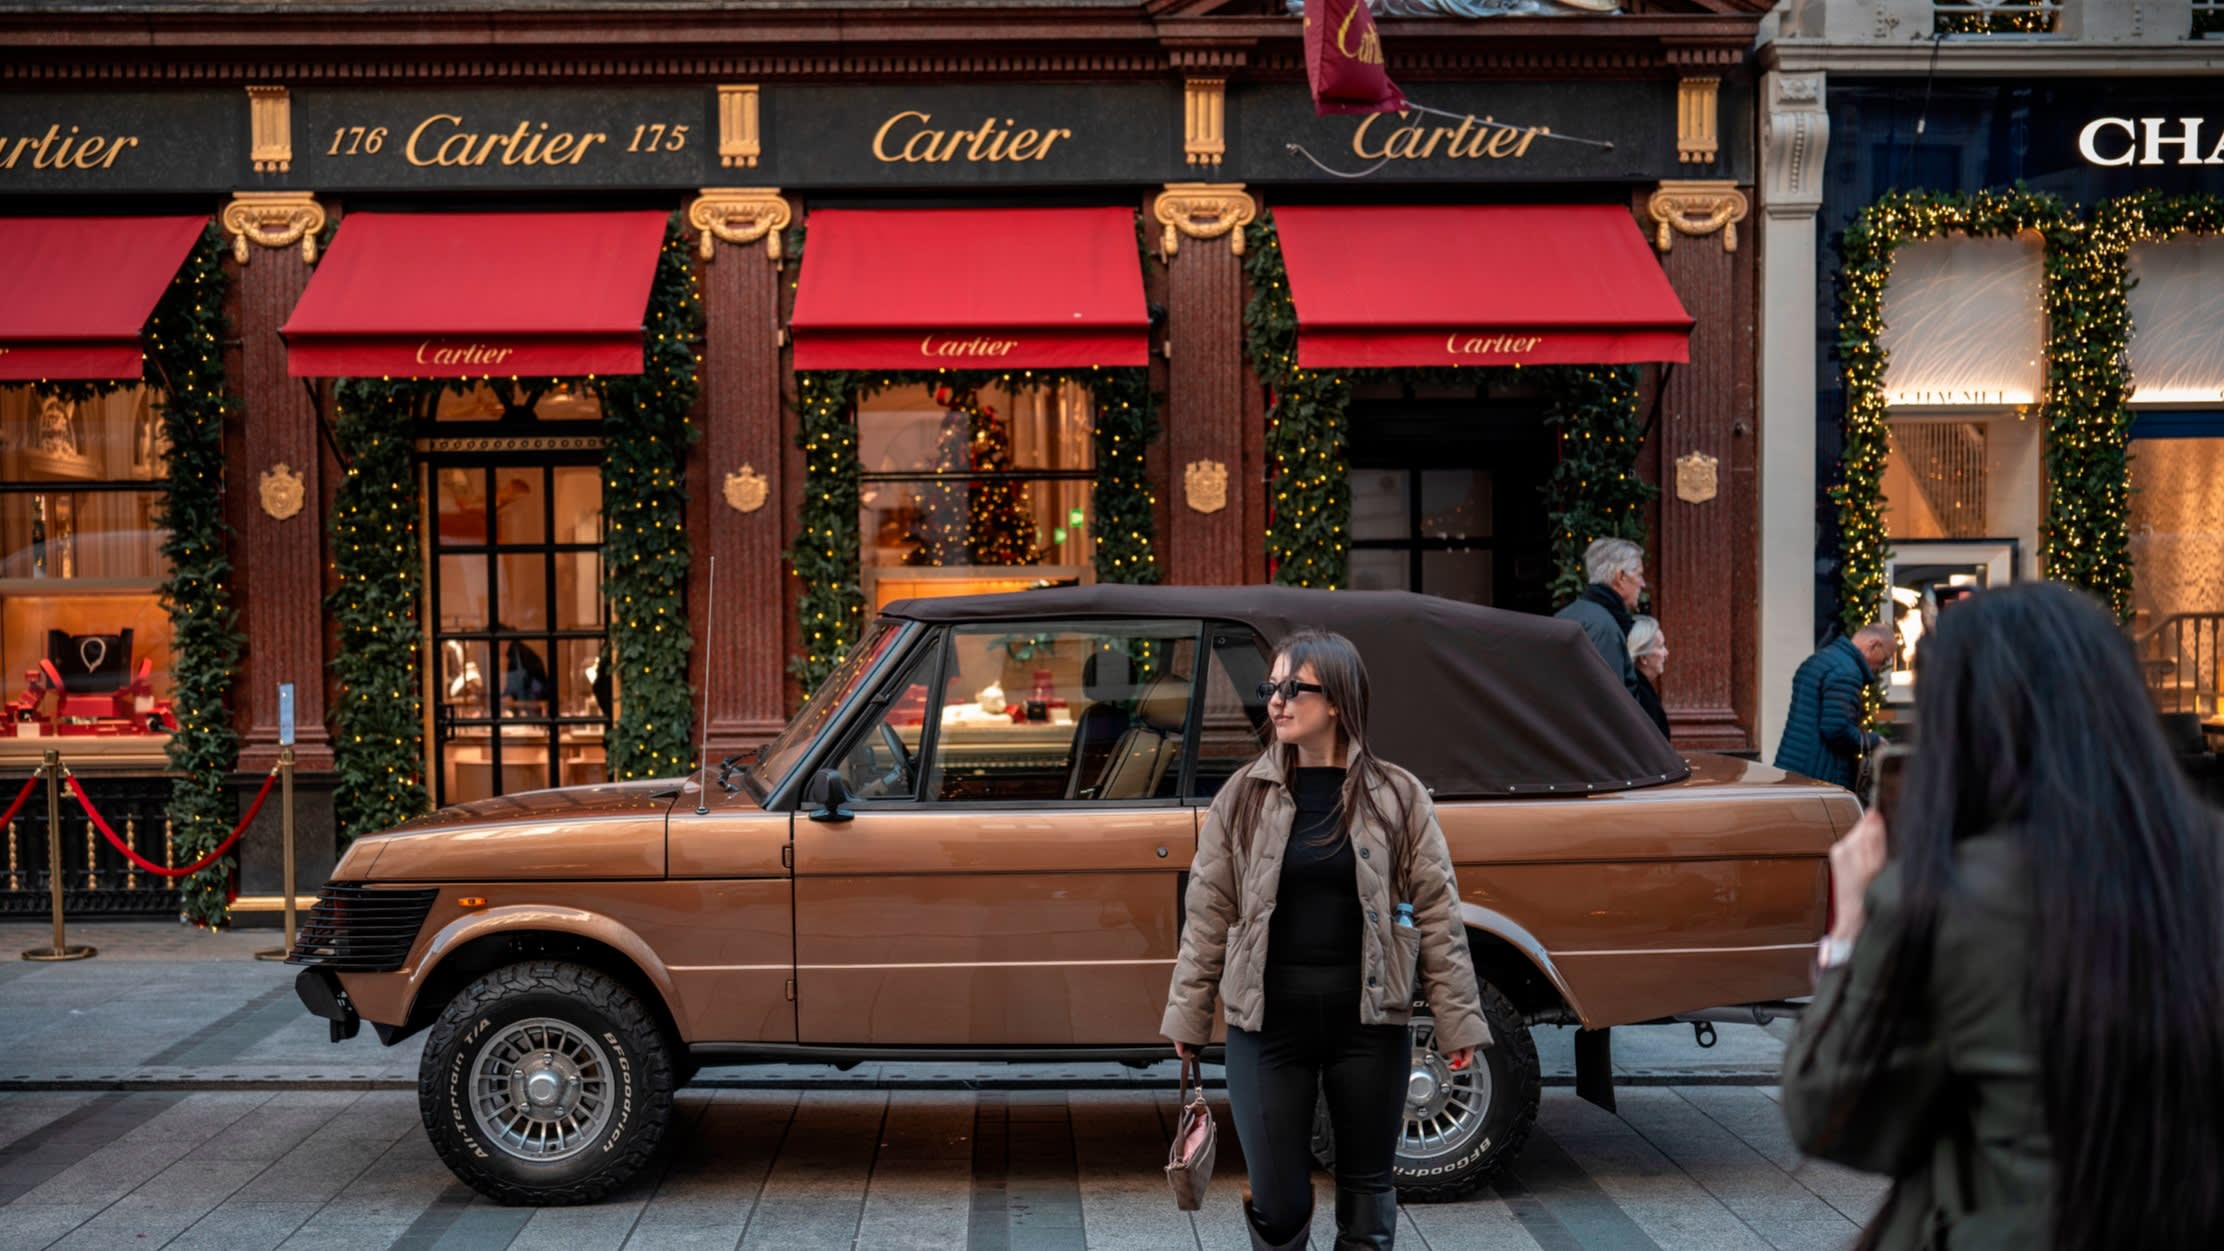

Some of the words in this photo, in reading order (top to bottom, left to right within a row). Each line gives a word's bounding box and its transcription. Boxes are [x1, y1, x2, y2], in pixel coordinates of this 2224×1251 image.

[327, 127, 388, 156] 176
[405, 114, 606, 166] Cartier
[626, 124, 689, 152] 175
[872, 110, 1072, 162] Cartier
[1352, 110, 1550, 160] Cartier
[416, 338, 513, 365] Cartier
[921, 335, 1019, 357] Cartier
[1446, 332, 1542, 354] Cartier
[450, 1052, 489, 1158] All-Terrain
[603, 1032, 632, 1152] BFGoodrich
[1392, 1137, 1491, 1177] BFGoodri
